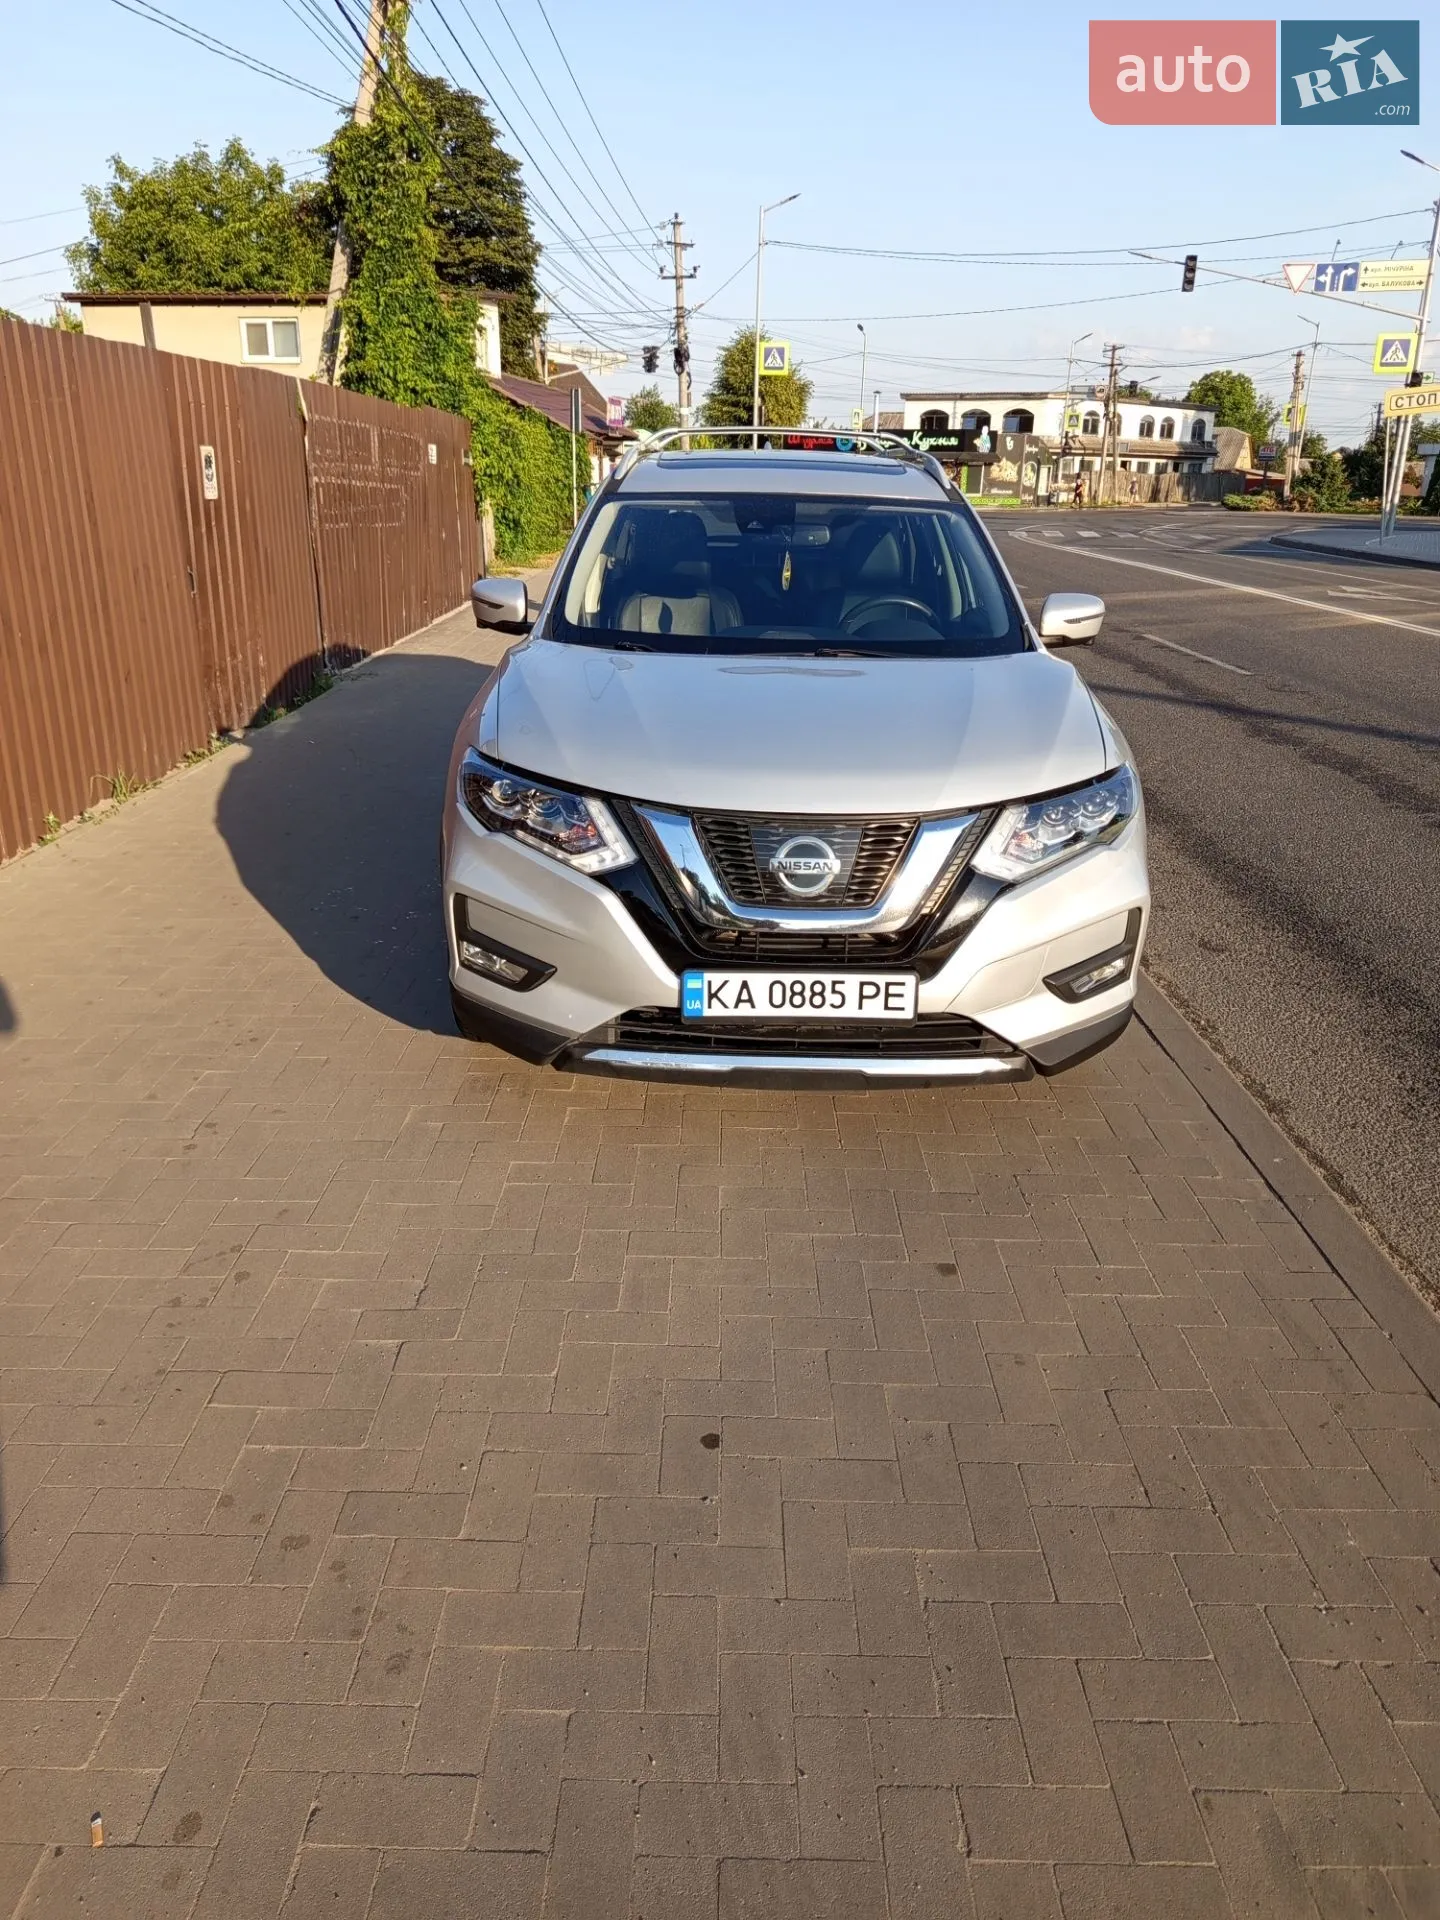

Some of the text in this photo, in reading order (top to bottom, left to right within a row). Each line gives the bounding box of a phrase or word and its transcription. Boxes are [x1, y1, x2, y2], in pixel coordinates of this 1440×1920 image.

[1395, 393, 1437, 408] СТОП
[911, 430, 959, 451] Кухня
[777, 861, 833, 871] NISSAN
[707, 980, 907, 1011] KA 0885 PE
[687, 1000, 702, 1009] UA
